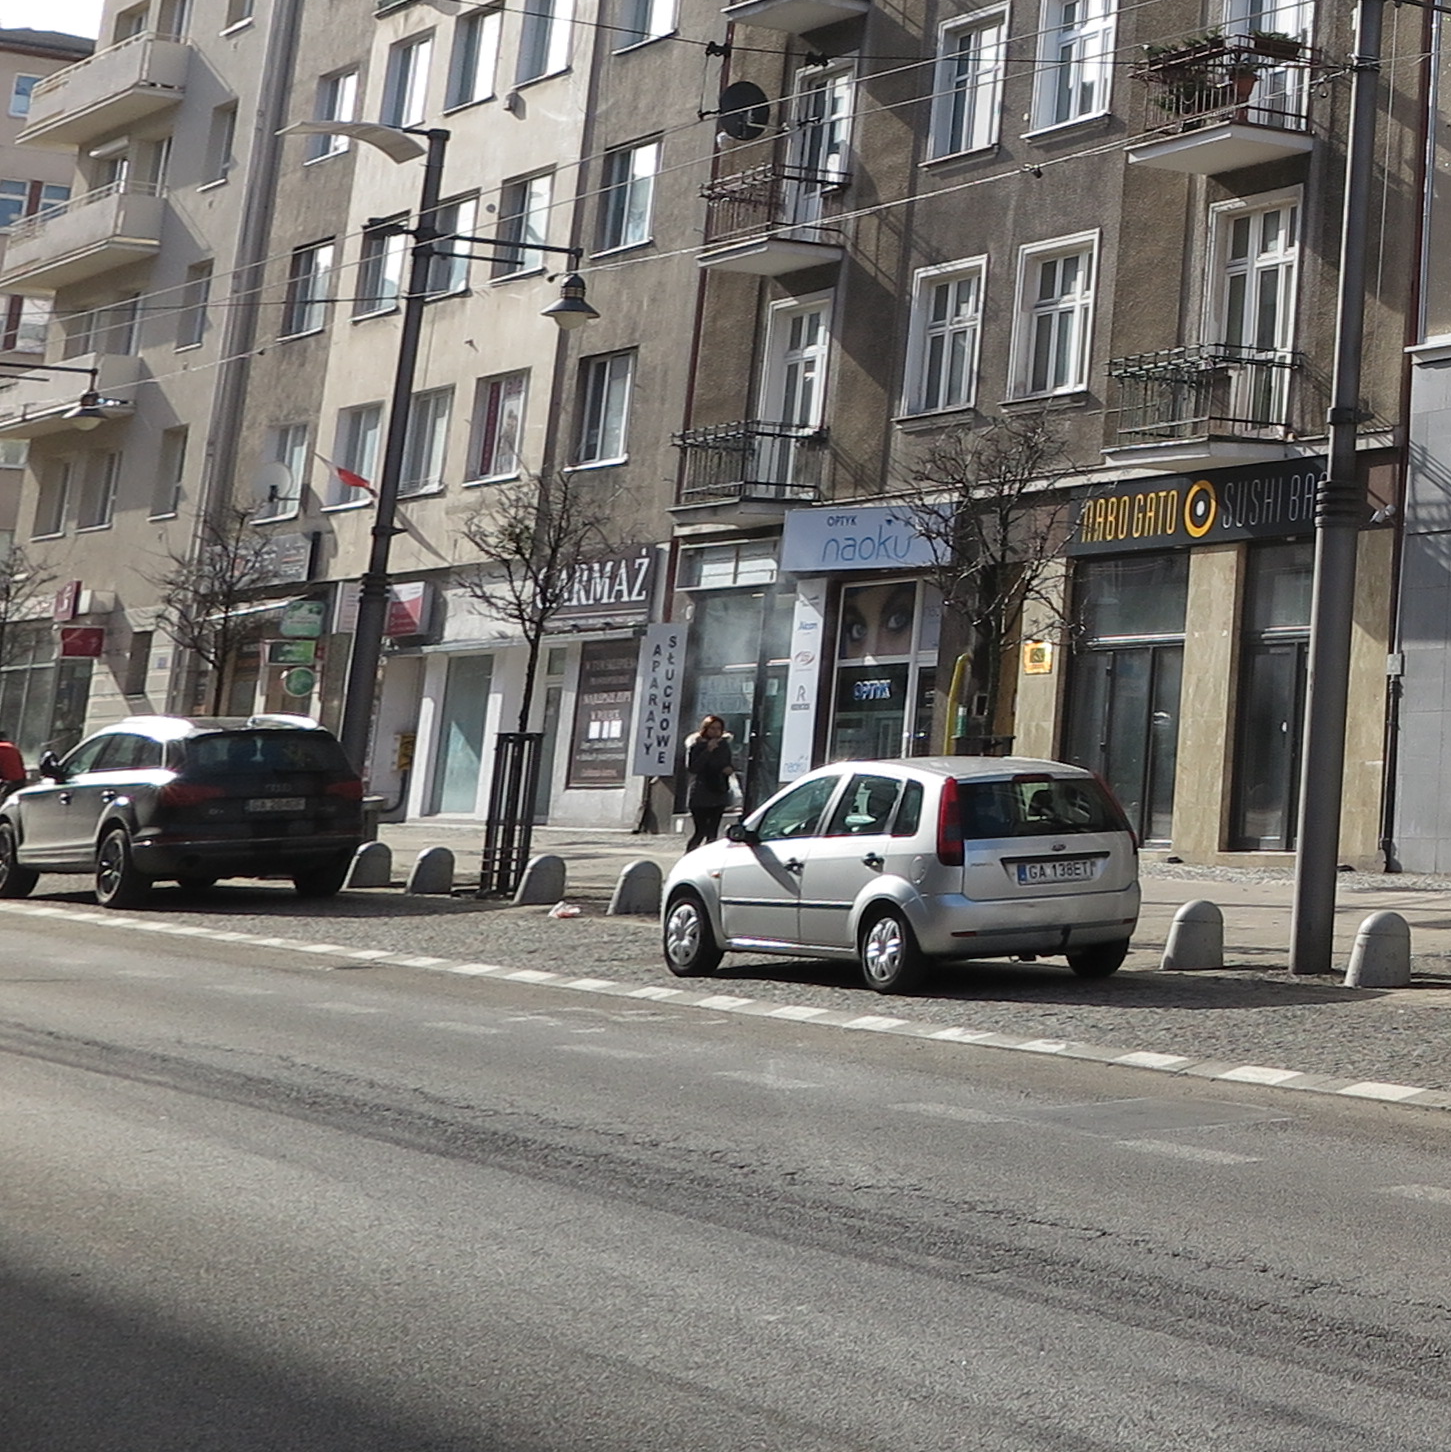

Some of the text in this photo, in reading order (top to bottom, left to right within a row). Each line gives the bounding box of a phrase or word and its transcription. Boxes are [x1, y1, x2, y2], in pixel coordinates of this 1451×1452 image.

[1131, 489, 1178, 538] GATO
[1222, 477, 1283, 529] SUSHI
[645, 643, 662, 756] APARATY
[656, 635, 678, 765] SŁUCHOWE
[1028, 863, 1047, 880] GA
